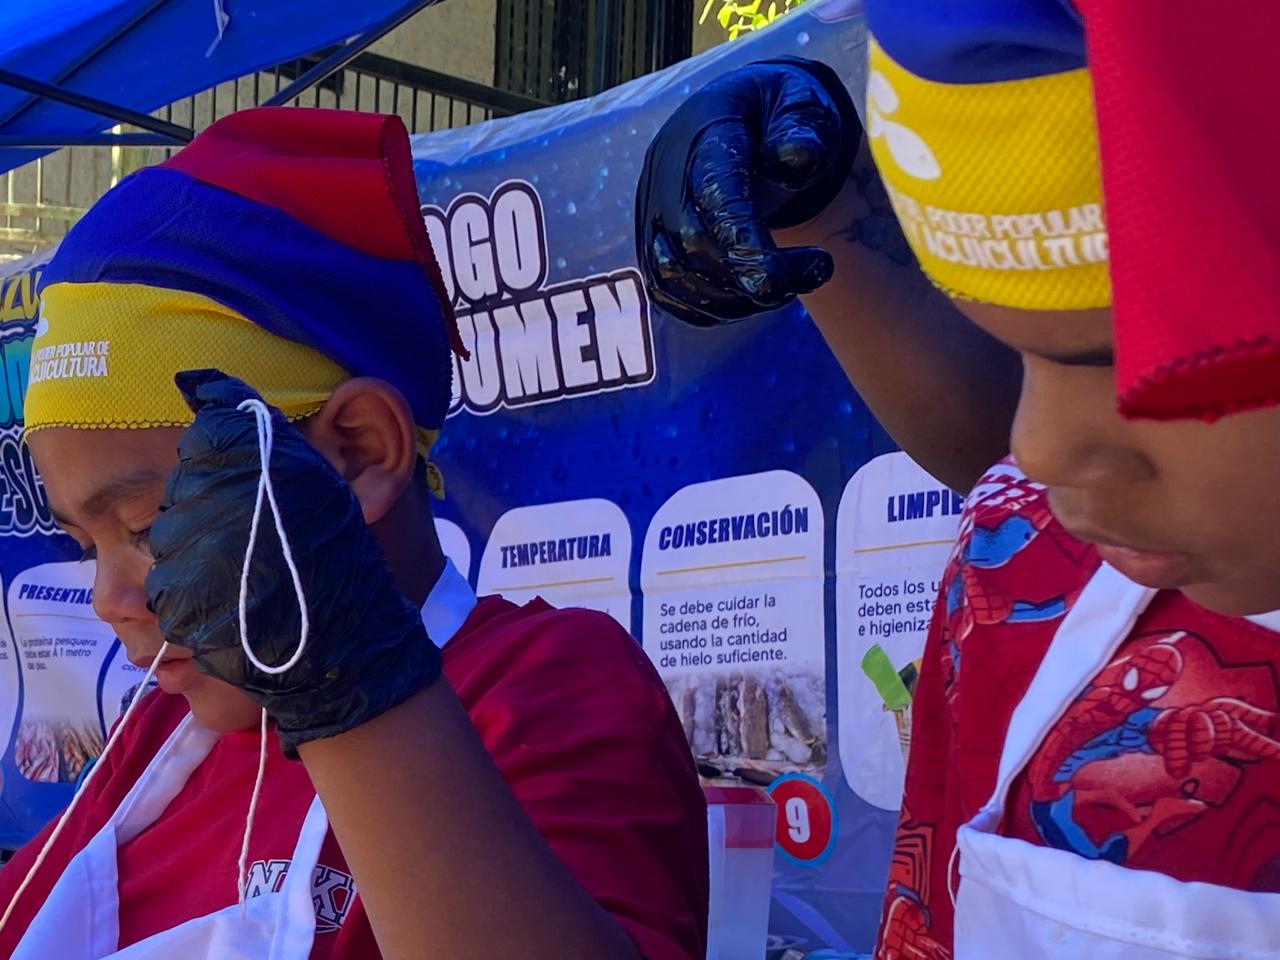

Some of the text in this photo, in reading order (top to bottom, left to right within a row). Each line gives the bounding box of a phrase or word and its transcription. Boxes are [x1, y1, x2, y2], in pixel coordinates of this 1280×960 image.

[422, 188, 542, 303] GO
[450, 277, 649, 409] UMEN
[658, 505, 809, 551] CONSERVACIÓN
[500, 533, 612, 569] TEMPERATURA
[858, 582, 899, 599] Todos
[903, 580, 925, 595] los
[660, 594, 776, 617] Se debe cuidar la
[858, 602, 901, 618] deben
[660, 612, 760, 634] cadena de frío,
[858, 624, 866, 637] e
[54, 637, 98, 648] pesquera
[660, 628, 788, 652] usando la cantidad
[66, 648, 92, 658] metro
[660, 647, 788, 668] de hielo suficiente.
[784, 796, 811, 844] 9
